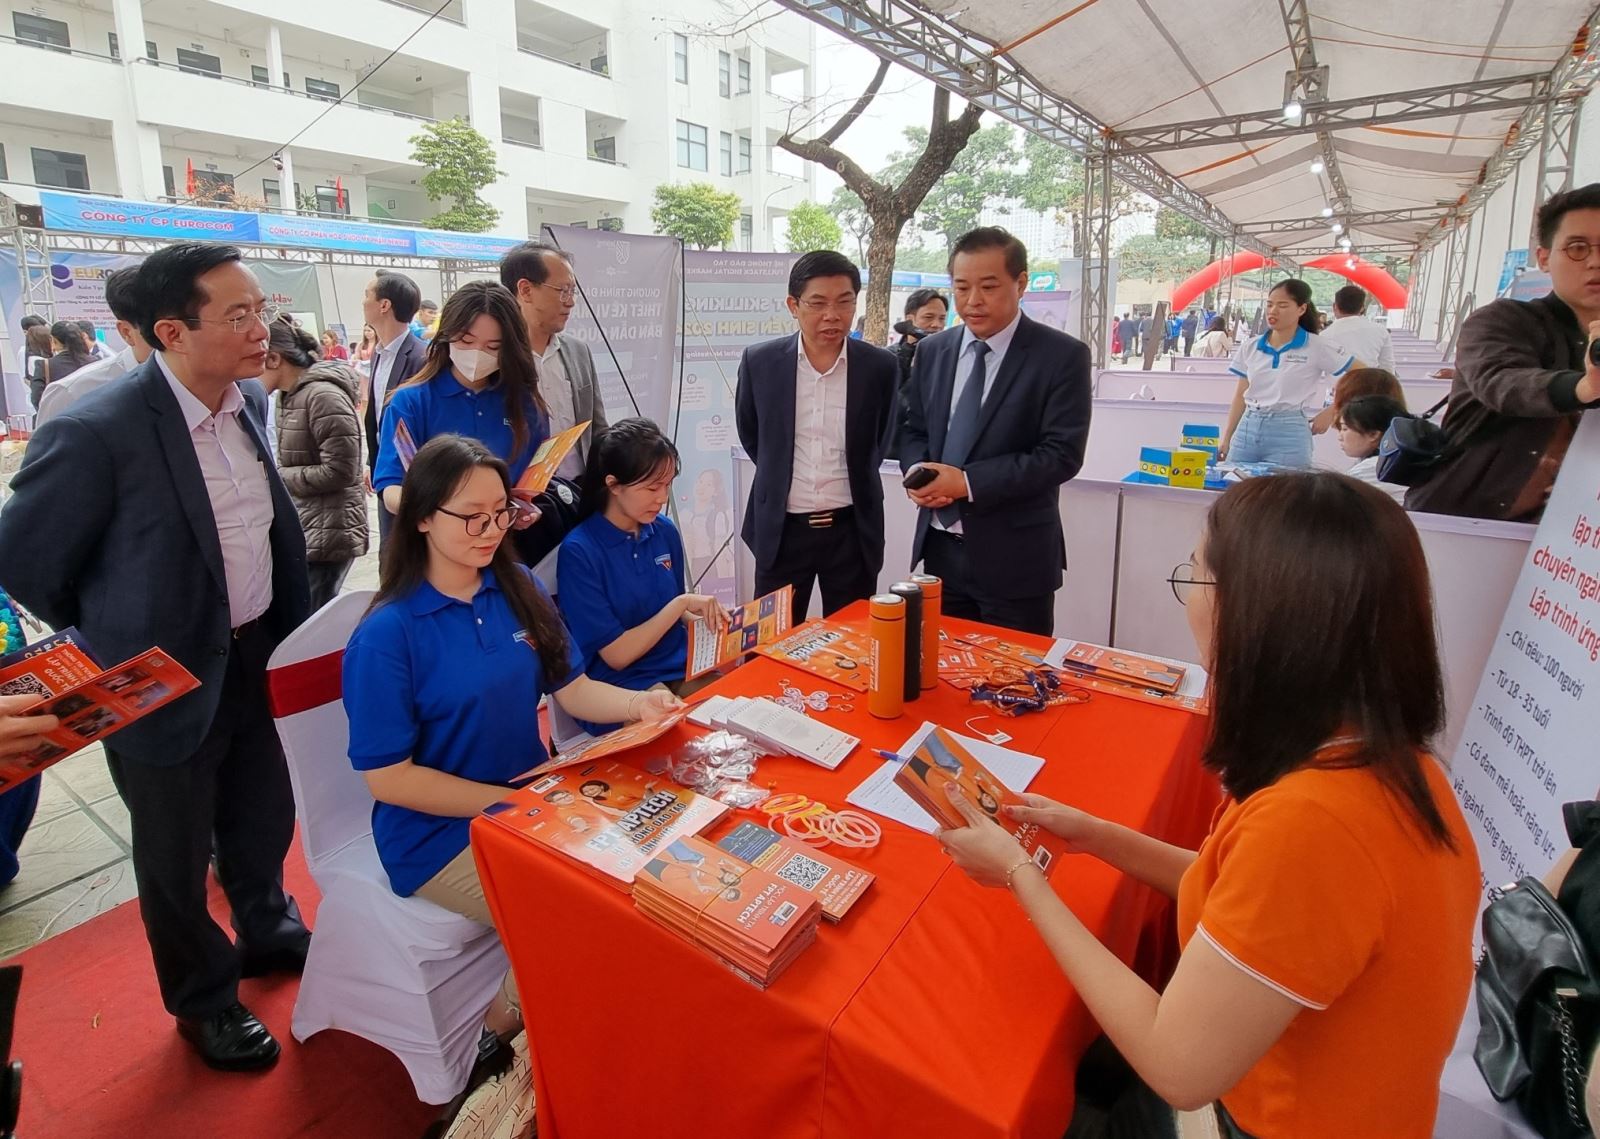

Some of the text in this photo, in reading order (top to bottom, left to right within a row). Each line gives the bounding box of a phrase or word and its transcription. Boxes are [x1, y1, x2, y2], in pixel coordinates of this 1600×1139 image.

[81, 209, 234, 231] CÔNG TY CP EUROCOM
[1533, 545, 1577, 585] chuyên
[1529, 586, 1551, 620] Lập
[1551, 602, 1578, 637] trình
[1511, 630, 1528, 651] Chỉ
[1543, 655, 1560, 678] 100
[1557, 670, 1585, 701] người
[1507, 680, 1520, 699] 18
[1522, 692, 1535, 713] 35
[1470, 741, 1482, 761] Có
[1483, 704, 1503, 734] Trình
[1513, 734, 1535, 766] THPT
[585, 789, 678, 852] FPT APTECH
[736, 882, 778, 924] FPT APTECH
